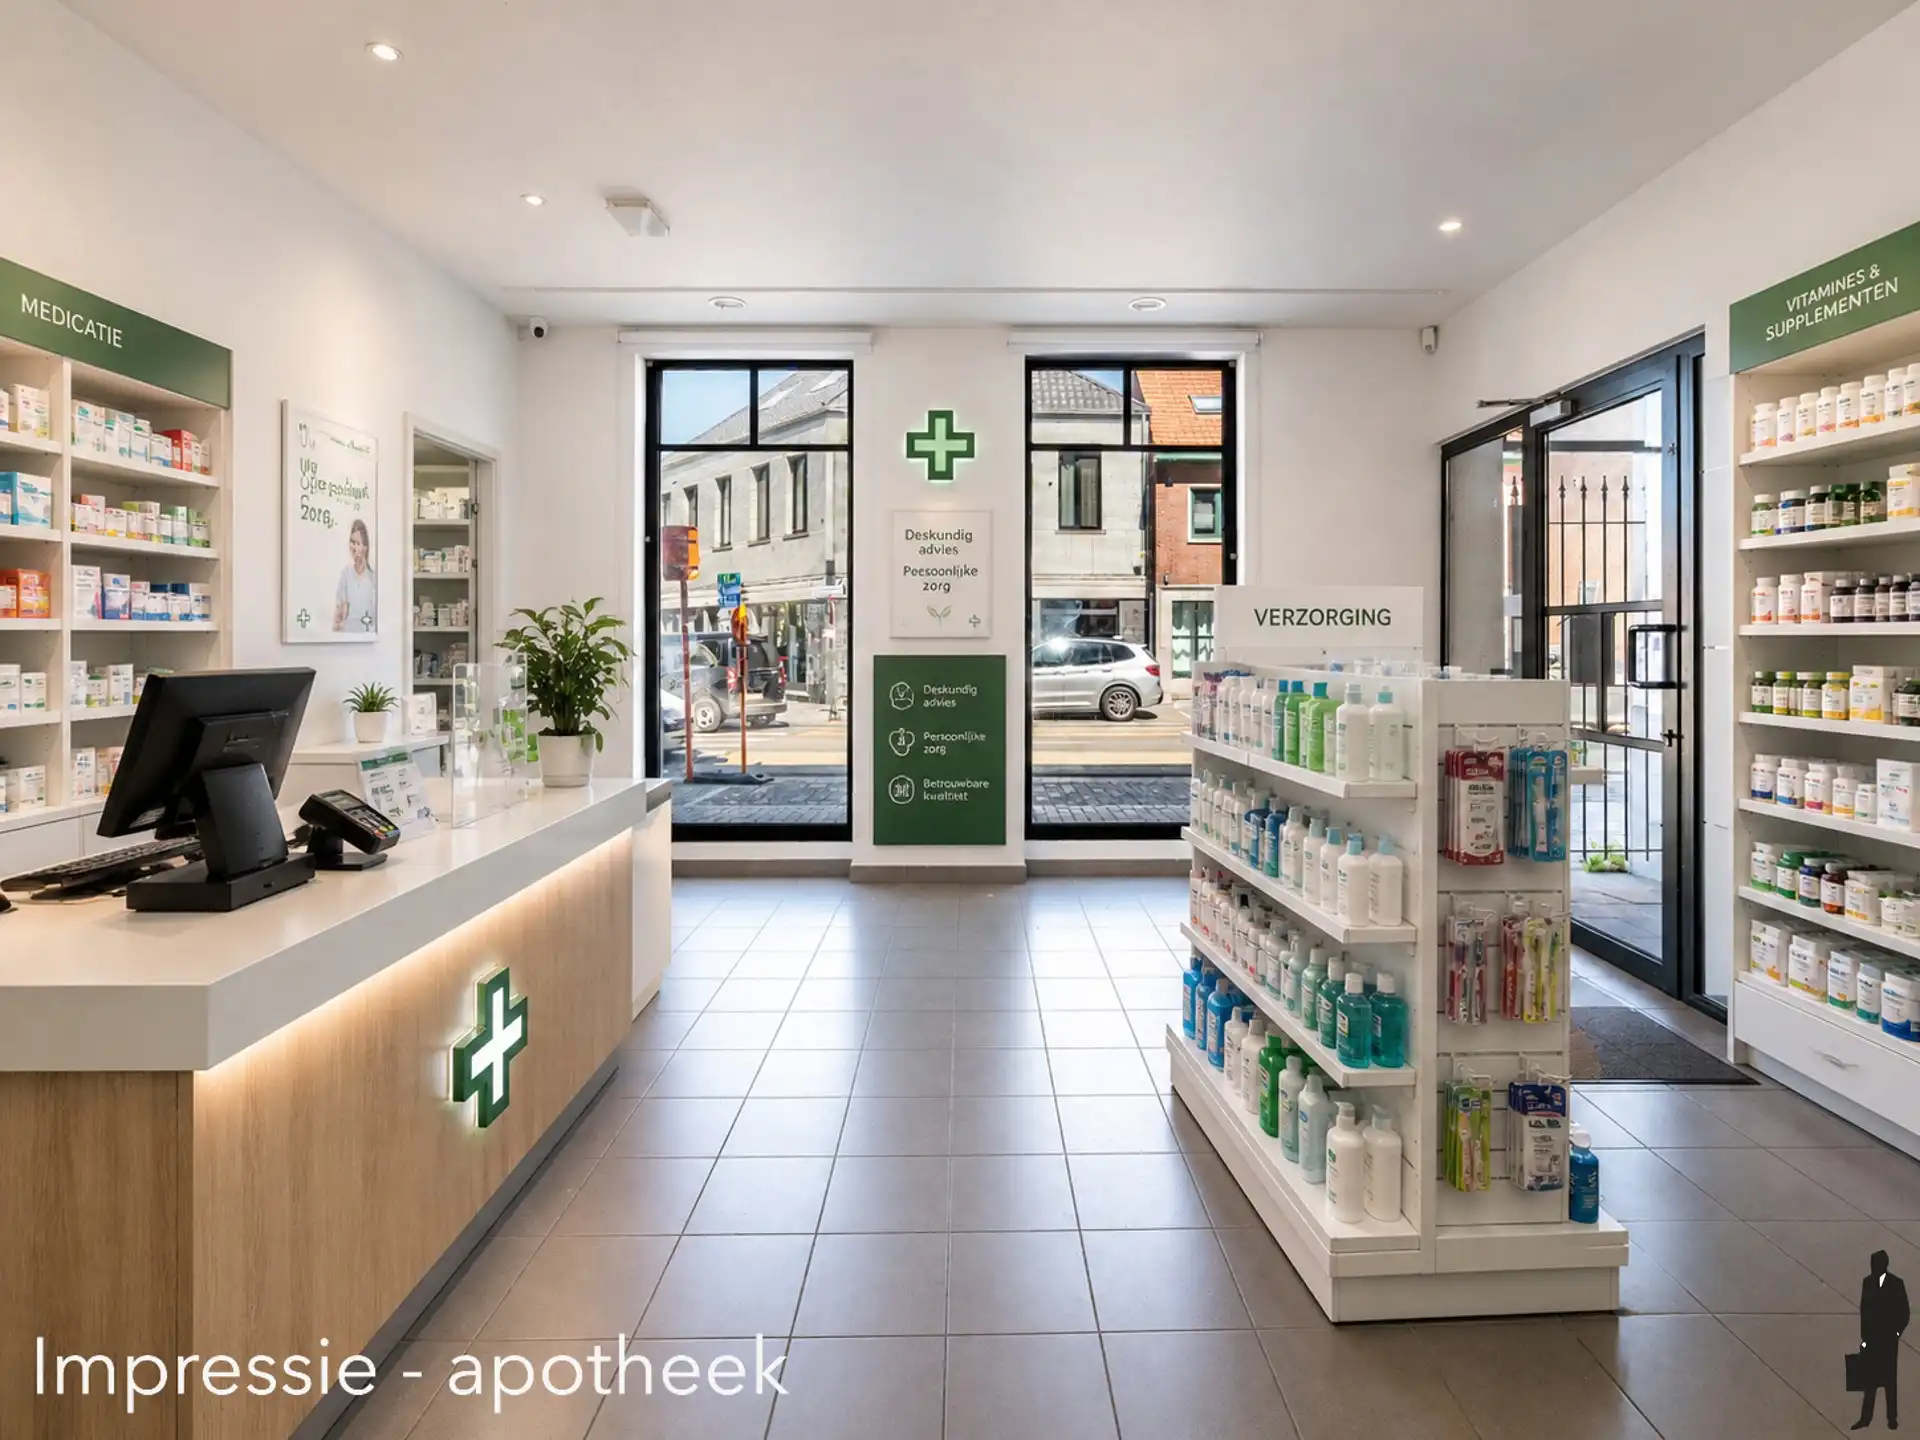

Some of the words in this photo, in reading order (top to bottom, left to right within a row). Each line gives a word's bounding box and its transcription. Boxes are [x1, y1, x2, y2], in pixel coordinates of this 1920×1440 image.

[1785, 268, 1865, 313] VITAMINES
[1868, 263, 1881, 280] &
[1765, 276, 1899, 342] SUPPLEMENTEN
[21, 292, 123, 349] MEDICATIE
[904, 528, 974, 544] Deskundig
[918, 543, 960, 556] advies
[922, 581, 952, 595] zorg
[1253, 607, 1392, 627] VERZORGING
